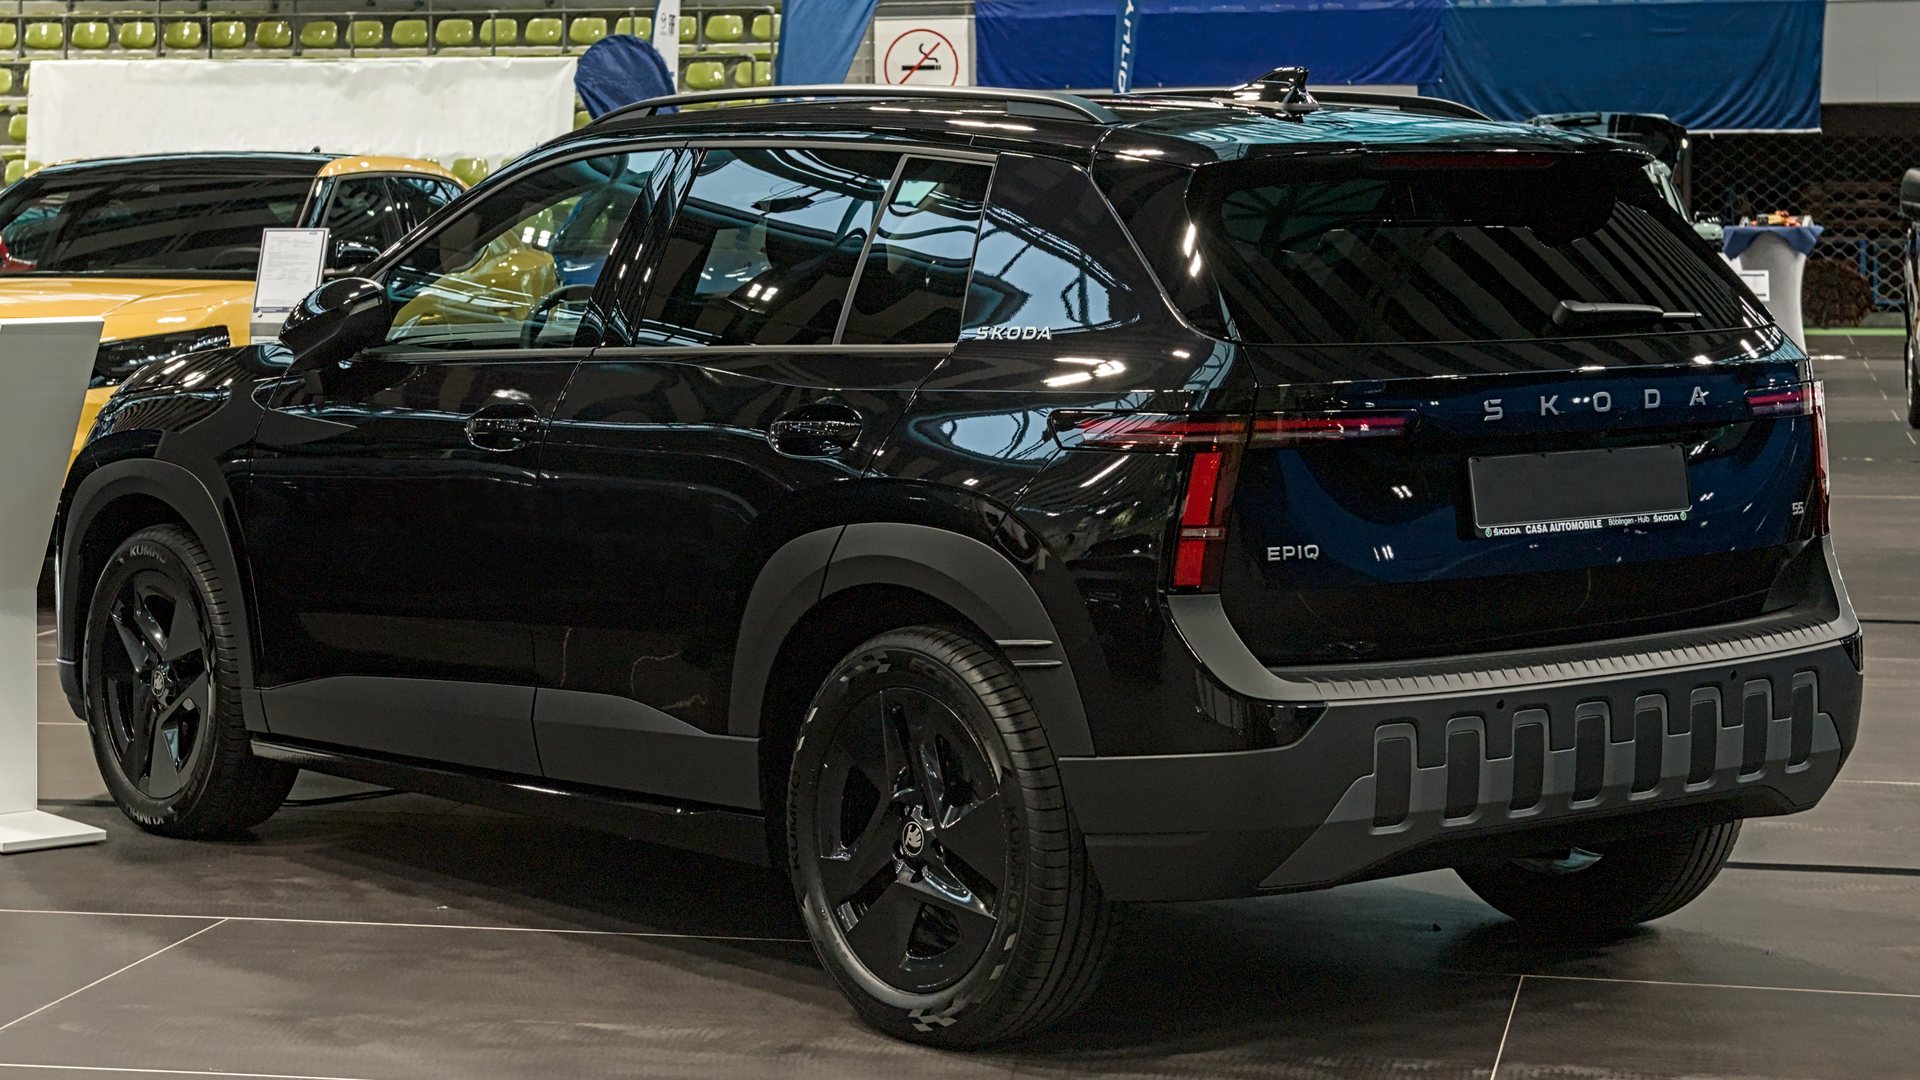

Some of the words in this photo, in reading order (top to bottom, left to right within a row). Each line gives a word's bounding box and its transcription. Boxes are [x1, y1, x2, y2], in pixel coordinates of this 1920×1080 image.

[1525, 525, 1548, 534] CASA
[1550, 519, 1602, 533] AUTOMOBILE
[1608, 517, 1634, 526] Böblingen
[1267, 544, 1319, 562] EPIQ
